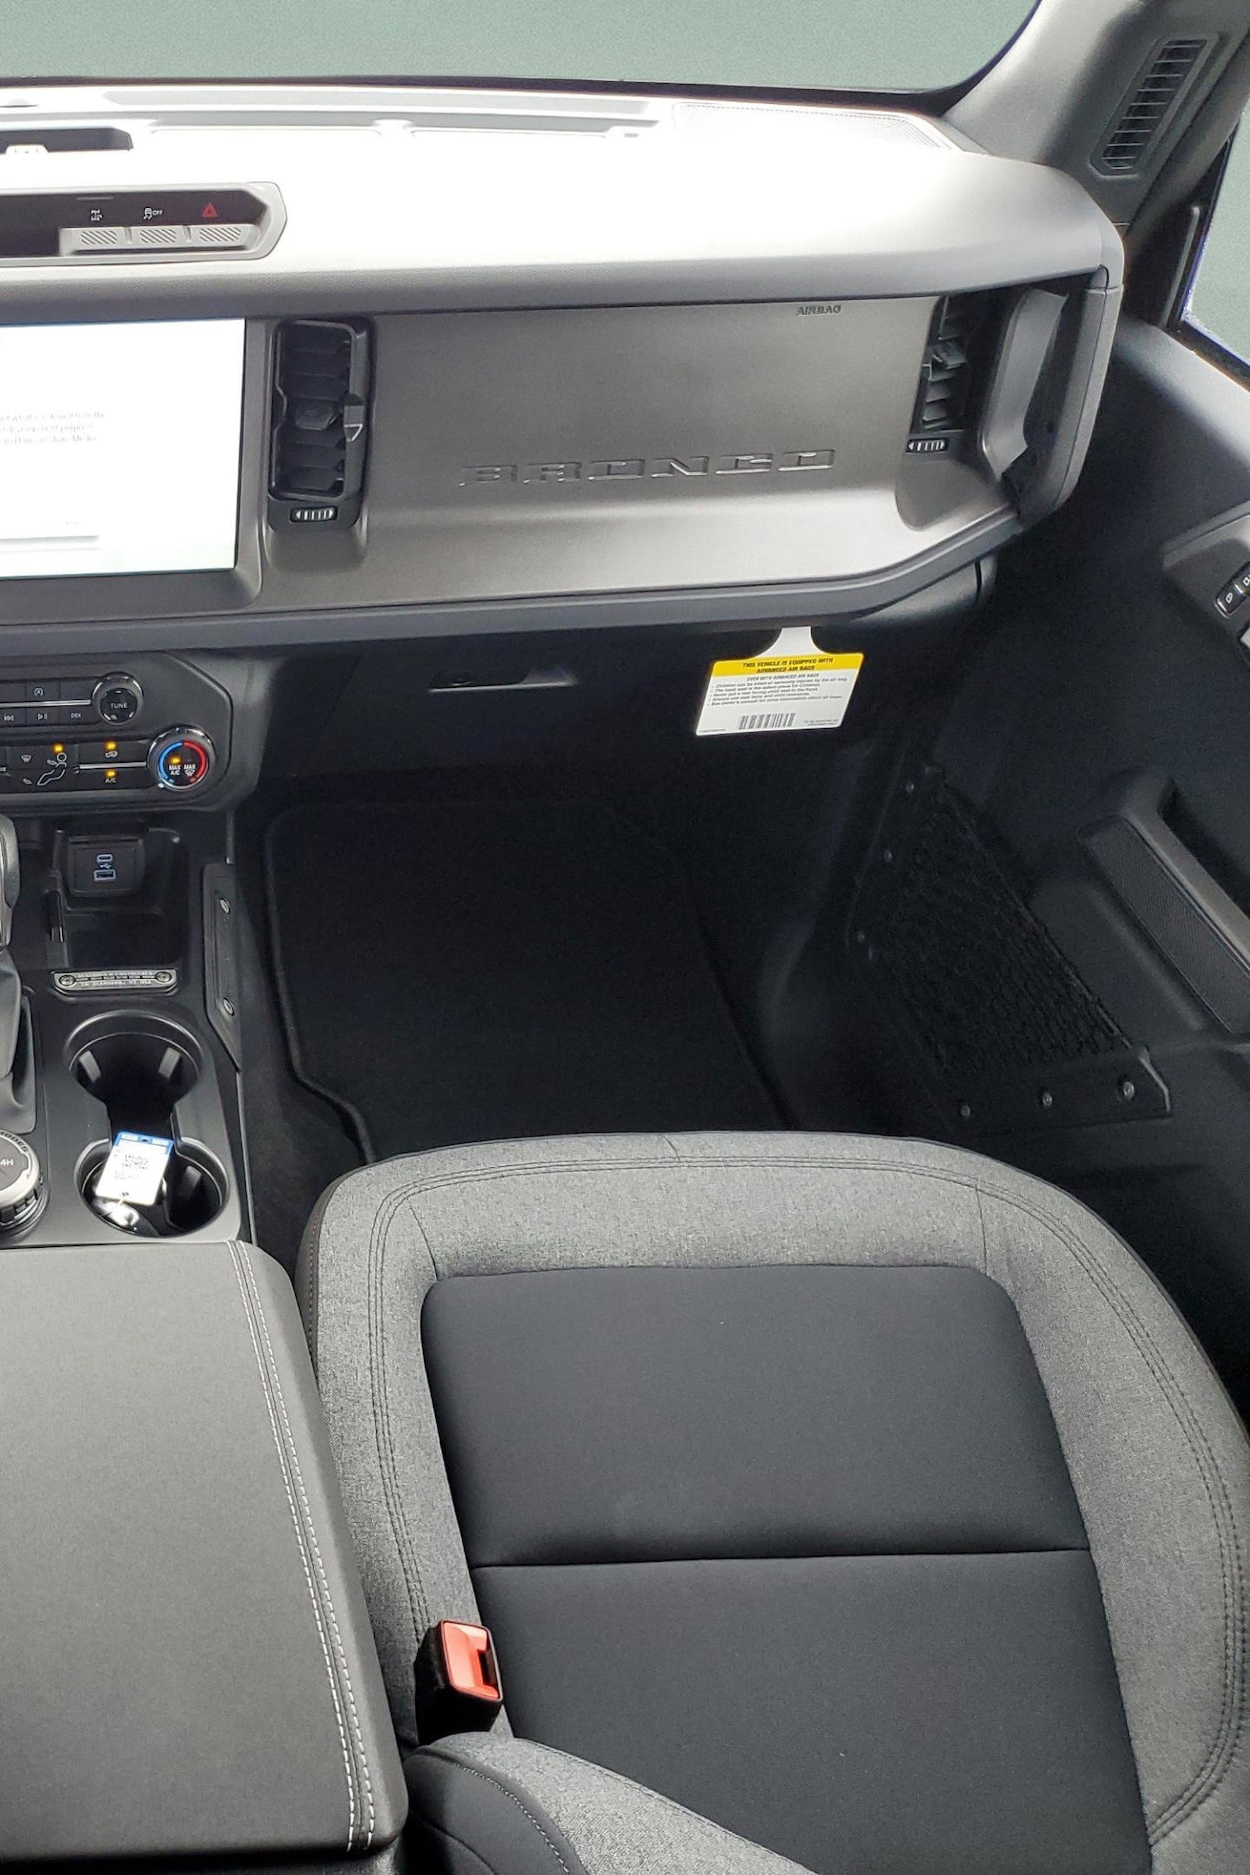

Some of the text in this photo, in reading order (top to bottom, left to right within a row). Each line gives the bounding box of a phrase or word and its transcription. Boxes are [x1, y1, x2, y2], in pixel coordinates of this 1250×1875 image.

[795, 304, 841, 316] AIRBAG
[458, 448, 836, 486] BRONCO
[757, 660, 781, 668] VEHICLE
[788, 658, 817, 666] EQUIPPED
[756, 666, 787, 674] ADVANCED
[0, 1159, 14, 1167] 4H
